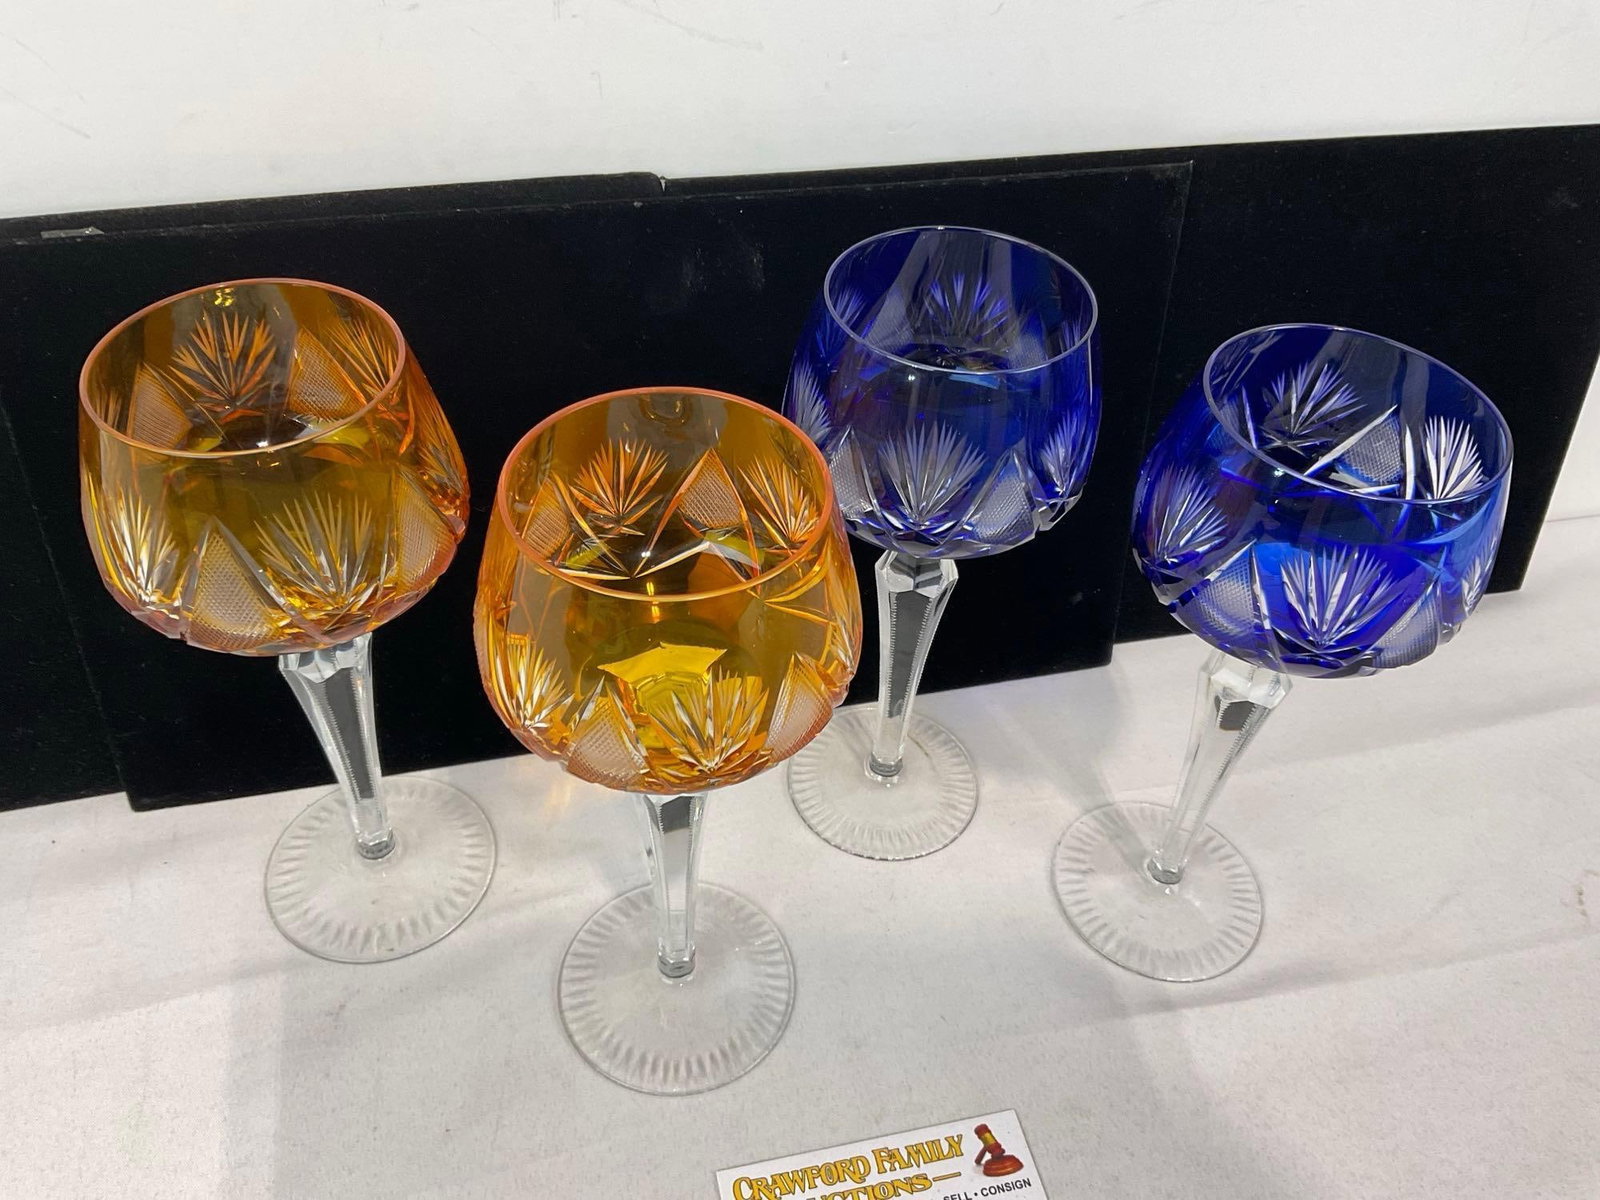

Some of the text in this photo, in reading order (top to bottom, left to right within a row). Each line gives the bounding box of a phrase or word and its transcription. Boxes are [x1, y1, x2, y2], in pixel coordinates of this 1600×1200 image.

[732, 1133, 964, 1200] CRAWFORD FAMILY
[805, 1173, 933, 1200] TIONS
[980, 1177, 1032, 1197] CONSIGN
